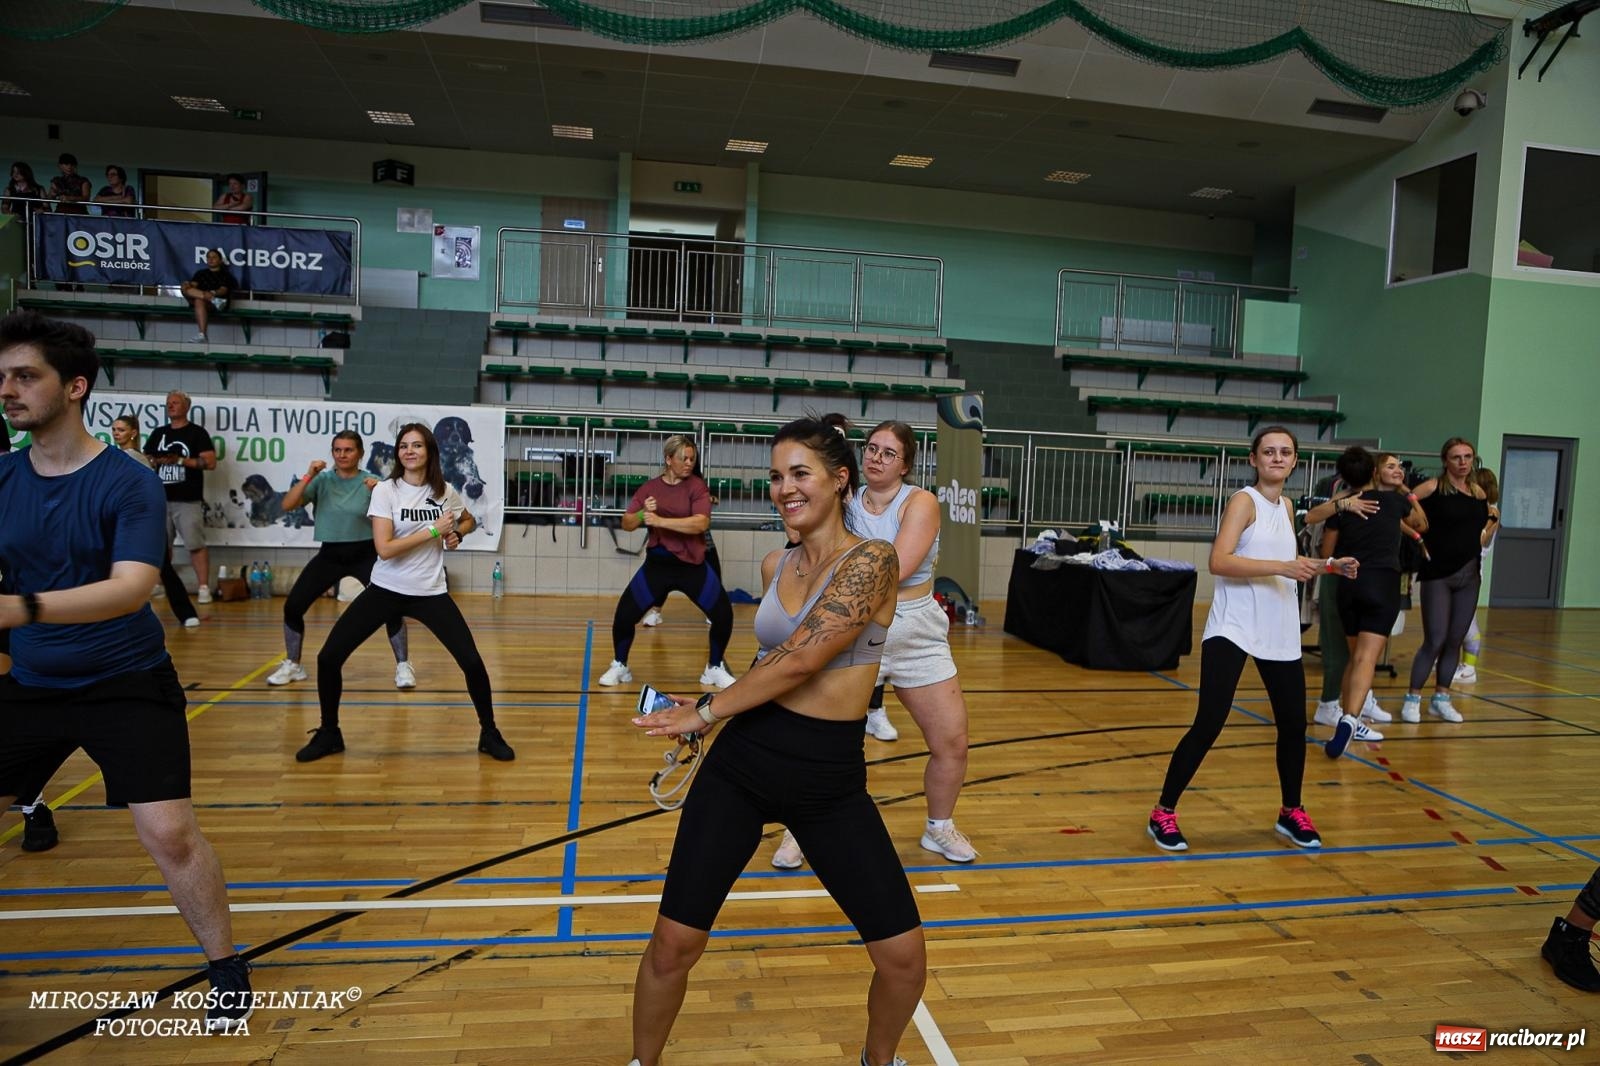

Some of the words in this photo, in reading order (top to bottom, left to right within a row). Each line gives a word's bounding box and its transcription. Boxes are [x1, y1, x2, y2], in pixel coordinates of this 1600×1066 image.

[396, 168, 409, 180] F
[100, 260, 151, 271] RACIBÓRZ
[84, 402, 206, 431] WSZYSTO
[216, 406, 260, 433] DLA
[268, 408, 376, 437] TWOJEGO
[236, 436, 286, 463] ZOO
[937, 479, 976, 506] salsa
[400, 508, 440, 521] PUMA
[950, 504, 976, 525] tion
